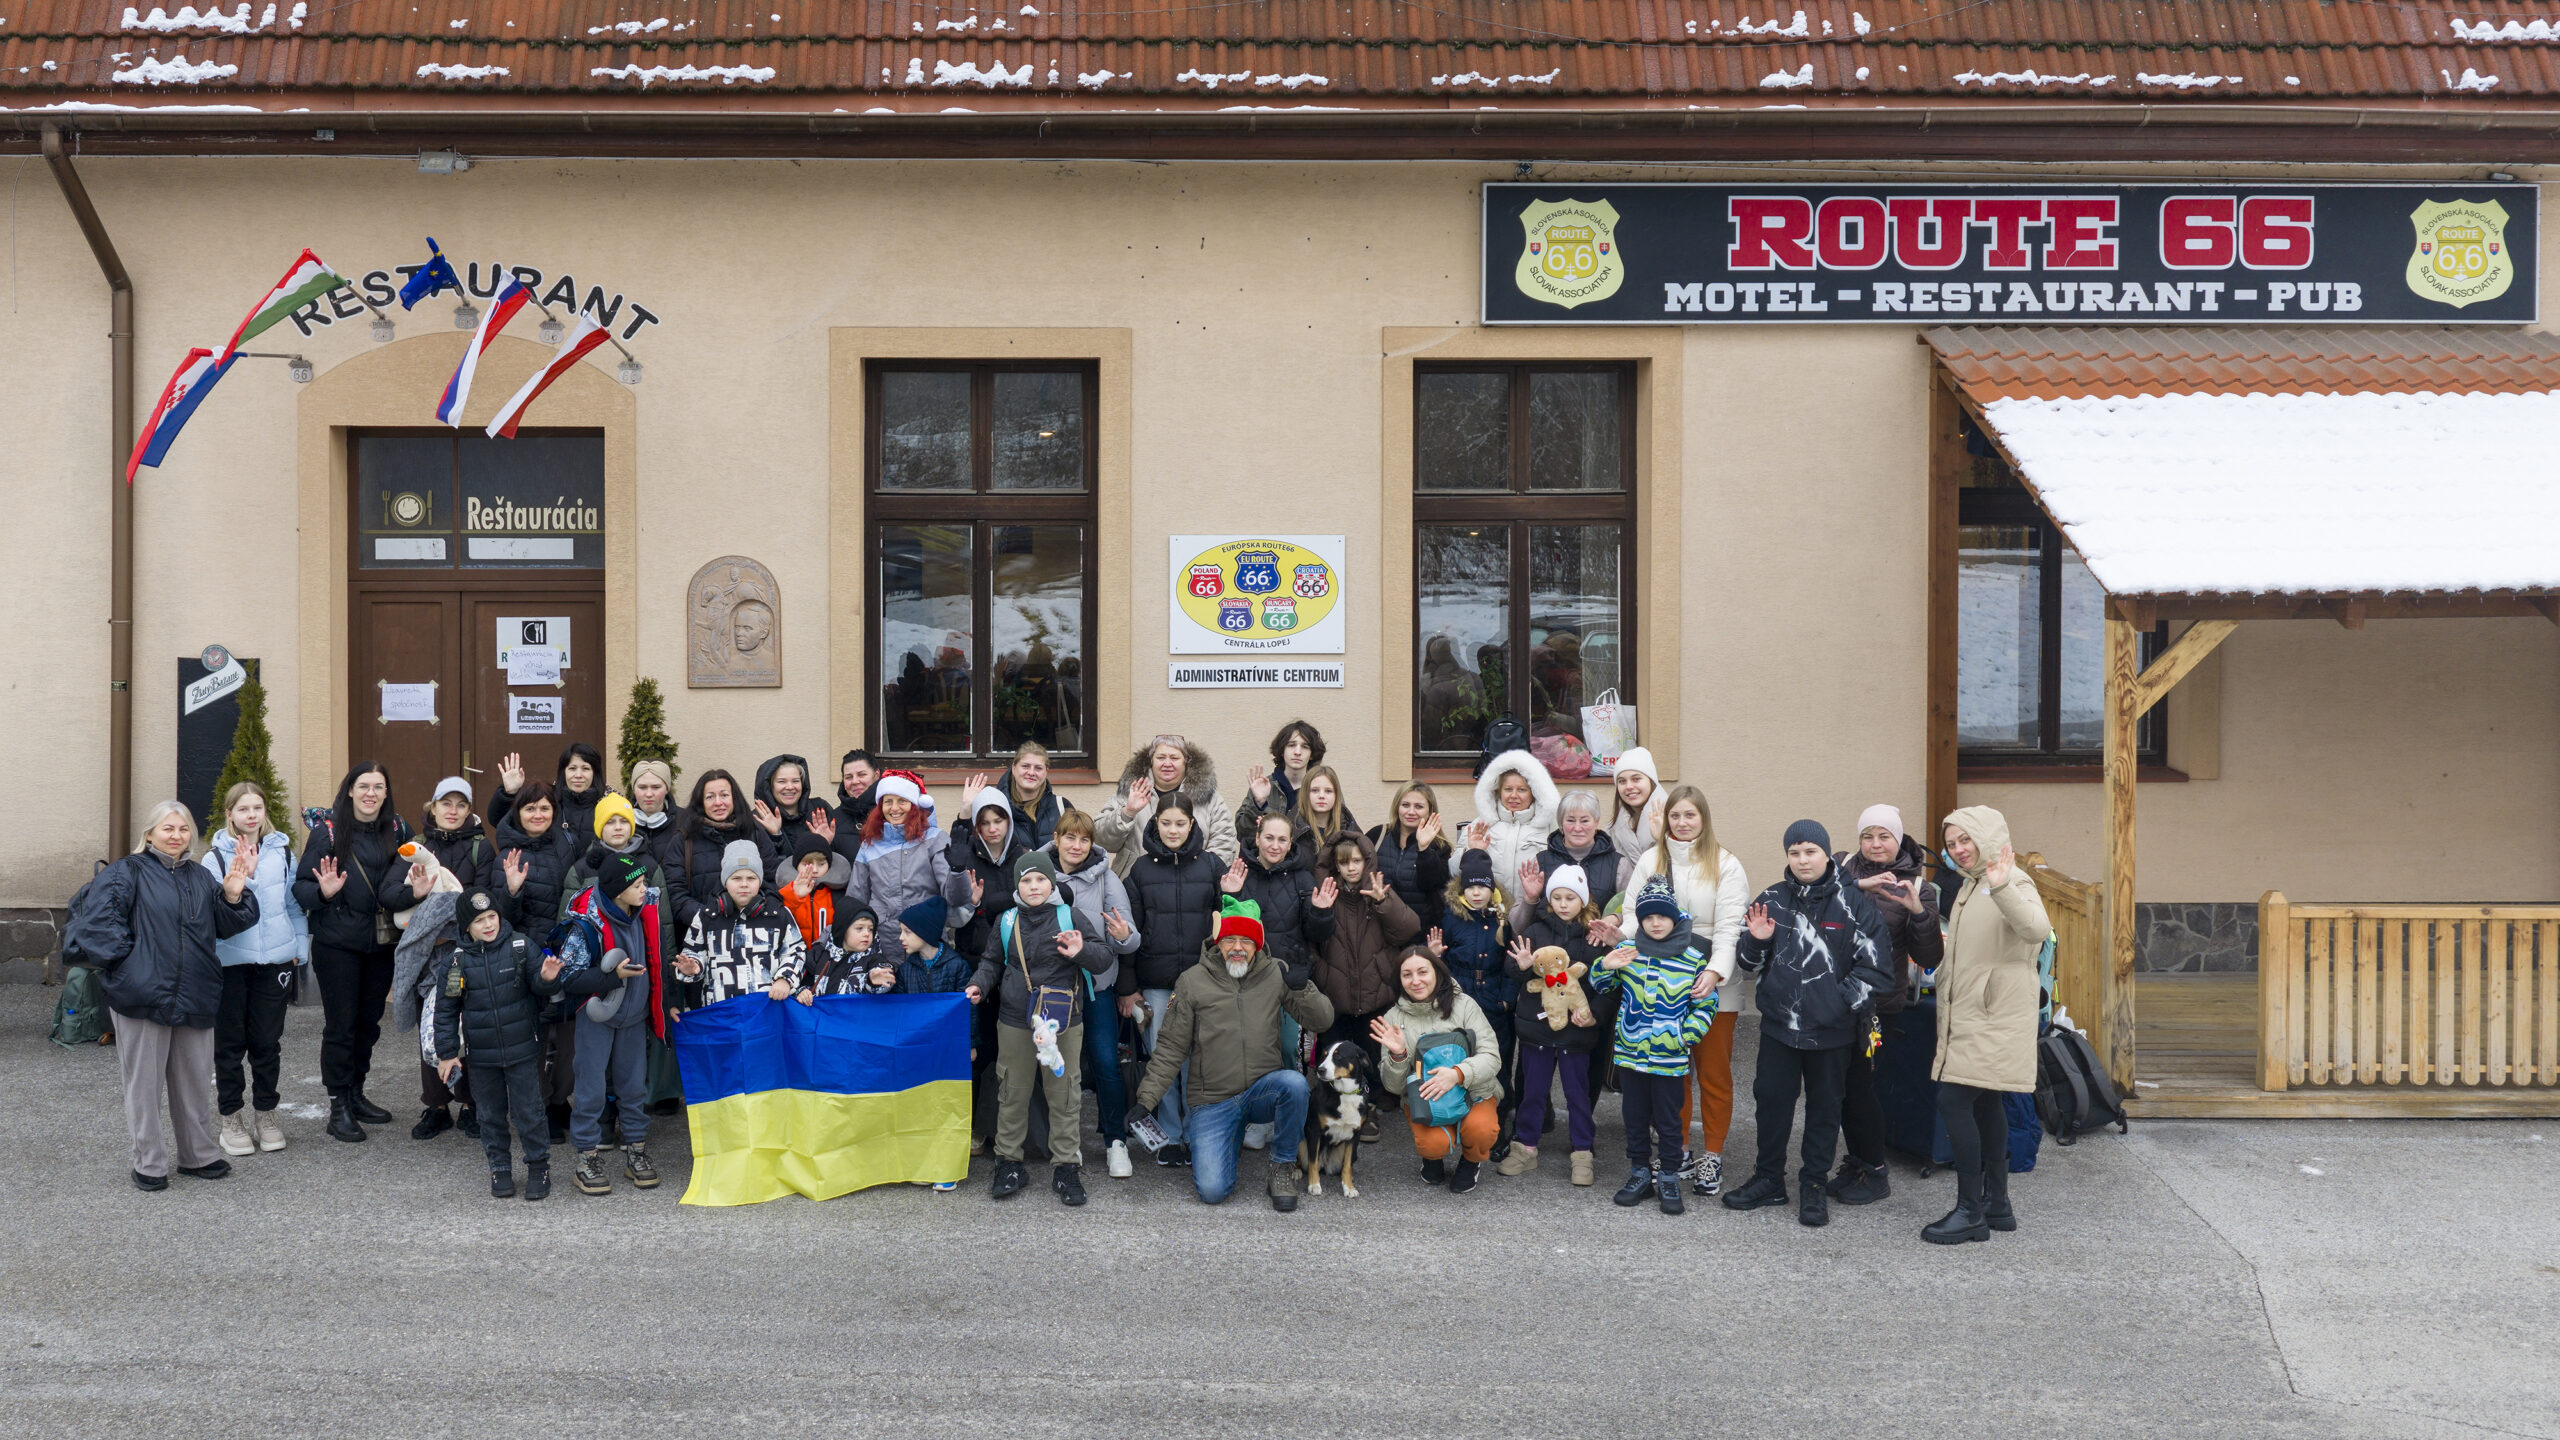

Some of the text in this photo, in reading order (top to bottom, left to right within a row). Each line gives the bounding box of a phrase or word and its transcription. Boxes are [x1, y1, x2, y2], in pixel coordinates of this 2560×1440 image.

[1531, 208, 1610, 236] SLOVENSKÁ ASOCIÁCIA
[2422, 208, 2500, 236] SLOVENSKÁ ASOCIÁCIA
[1551, 229, 1589, 239] ROUTE
[1728, 196, 2315, 271] ROUTE 66
[2442, 229, 2479, 239] ROUTE
[1530, 266, 1612, 298] SLOVAK ASSOCIATION
[2420, 265, 2501, 298] SLOVAK ASSOCIATION
[1663, 282, 1828, 312] MOTEL
[1872, 282, 2225, 312] RESTAURANT
[2268, 282, 2363, 312] PUB
[293, 368, 308, 380] 66
[467, 495, 598, 530] Reštaurácia
[1222, 541, 1260, 553] EURÓPSKA
[1240, 555, 1273, 563] EU ROUTE
[1245, 570, 1269, 586] 66
[1196, 581, 1217, 595] 66
[1300, 580, 1322, 594] 66
[1222, 600, 1250, 608] SLOVAKIA
[1225, 615, 1247, 628] 66
[1269, 614, 1290, 627] 66
[1224, 638, 1290, 648] CENTRÁLA LOPEJ
[1175, 665, 1339, 683] ADMINISTRATÍVNE CENTRUM
